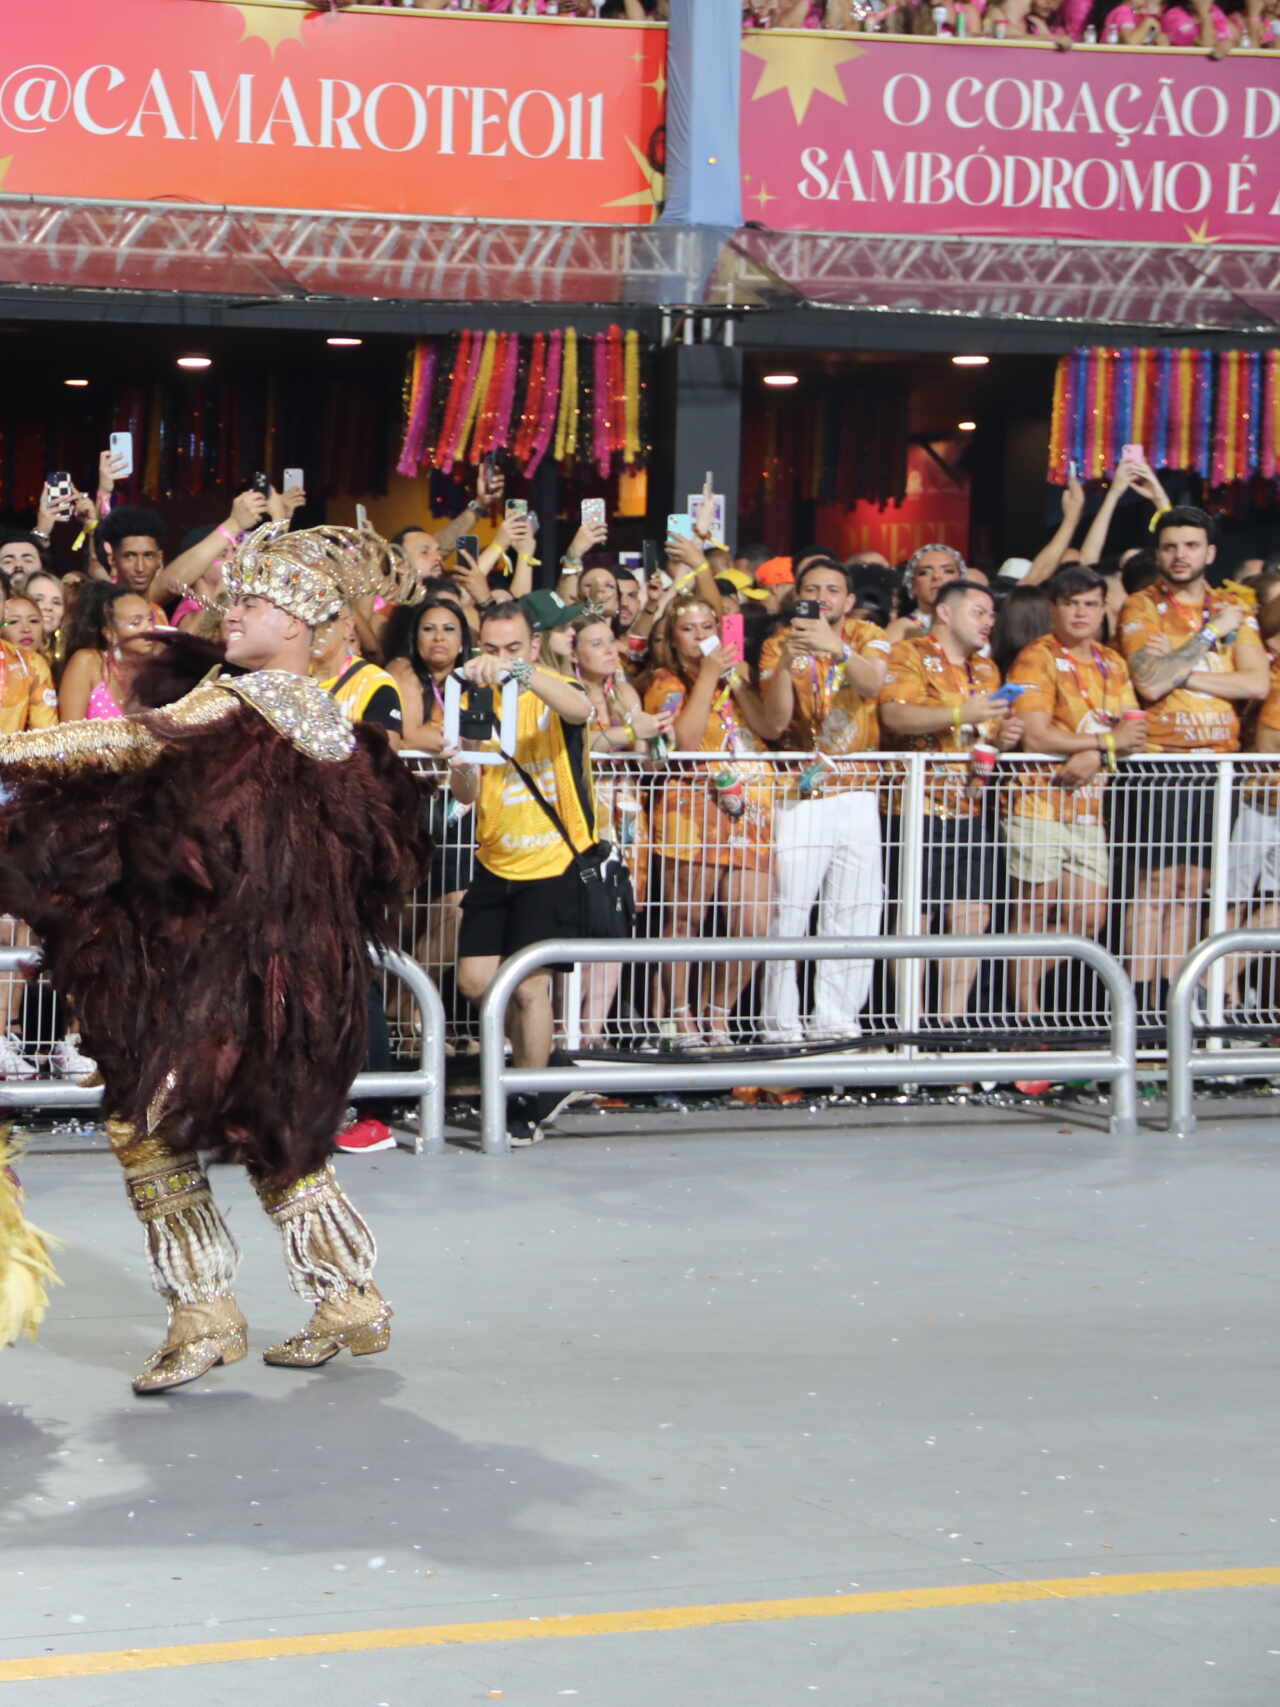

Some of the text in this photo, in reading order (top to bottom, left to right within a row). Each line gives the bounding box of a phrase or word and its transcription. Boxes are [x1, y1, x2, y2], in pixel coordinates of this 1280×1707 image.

[882, 72, 932, 127] O
[945, 76, 1229, 147] CORAÇÃO
[796, 145, 1213, 214] SAMBÓDROMO
[1225, 153, 1258, 215] É
